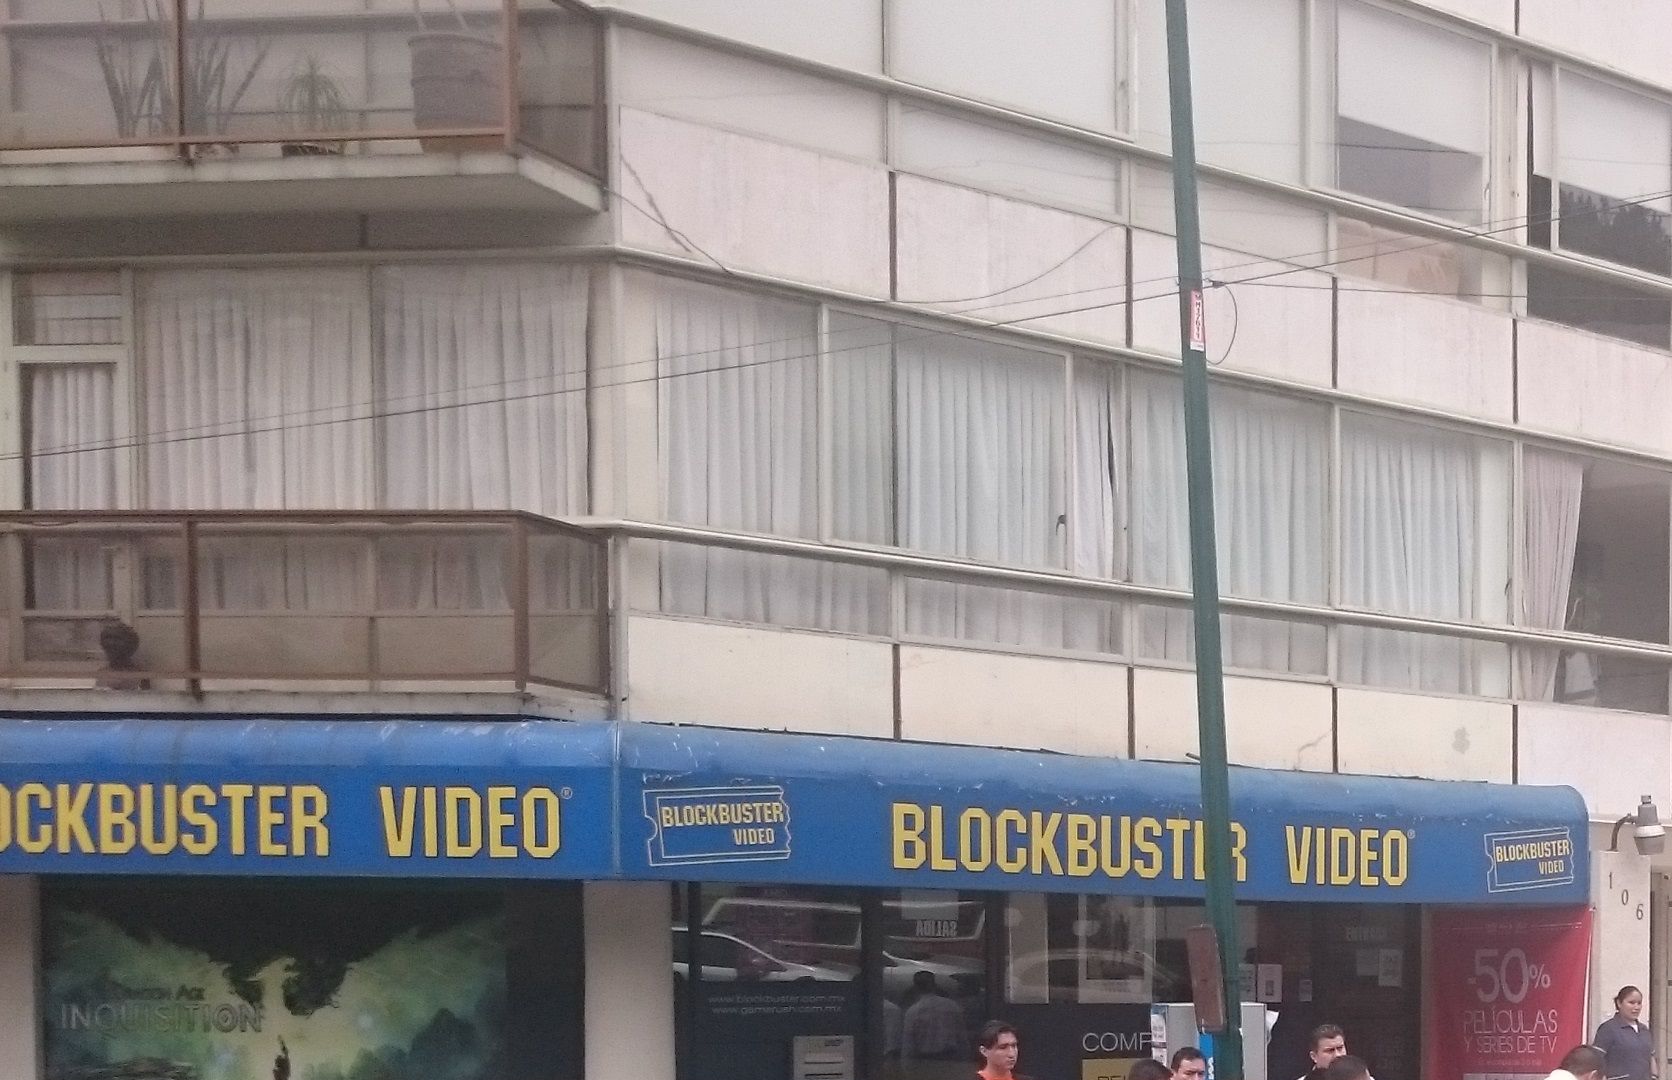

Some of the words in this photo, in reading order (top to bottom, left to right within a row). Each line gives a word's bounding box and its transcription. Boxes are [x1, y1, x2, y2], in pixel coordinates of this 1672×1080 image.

[380, 786, 560, 858] VIDEO
[661, 802, 784, 828] BLOCKBUSTER
[733, 828, 775, 845] VIDEO
[1285, 825, 1408, 886] VIDEO
[1496, 839, 1570, 863] BLOCKBUSTER
[1539, 860, 1565, 875] VIDEO
[60, 1002, 264, 1033] INQUISITION
[1517, 1035, 1536, 1053] DE
[1540, 1035, 1558, 1053] TV
